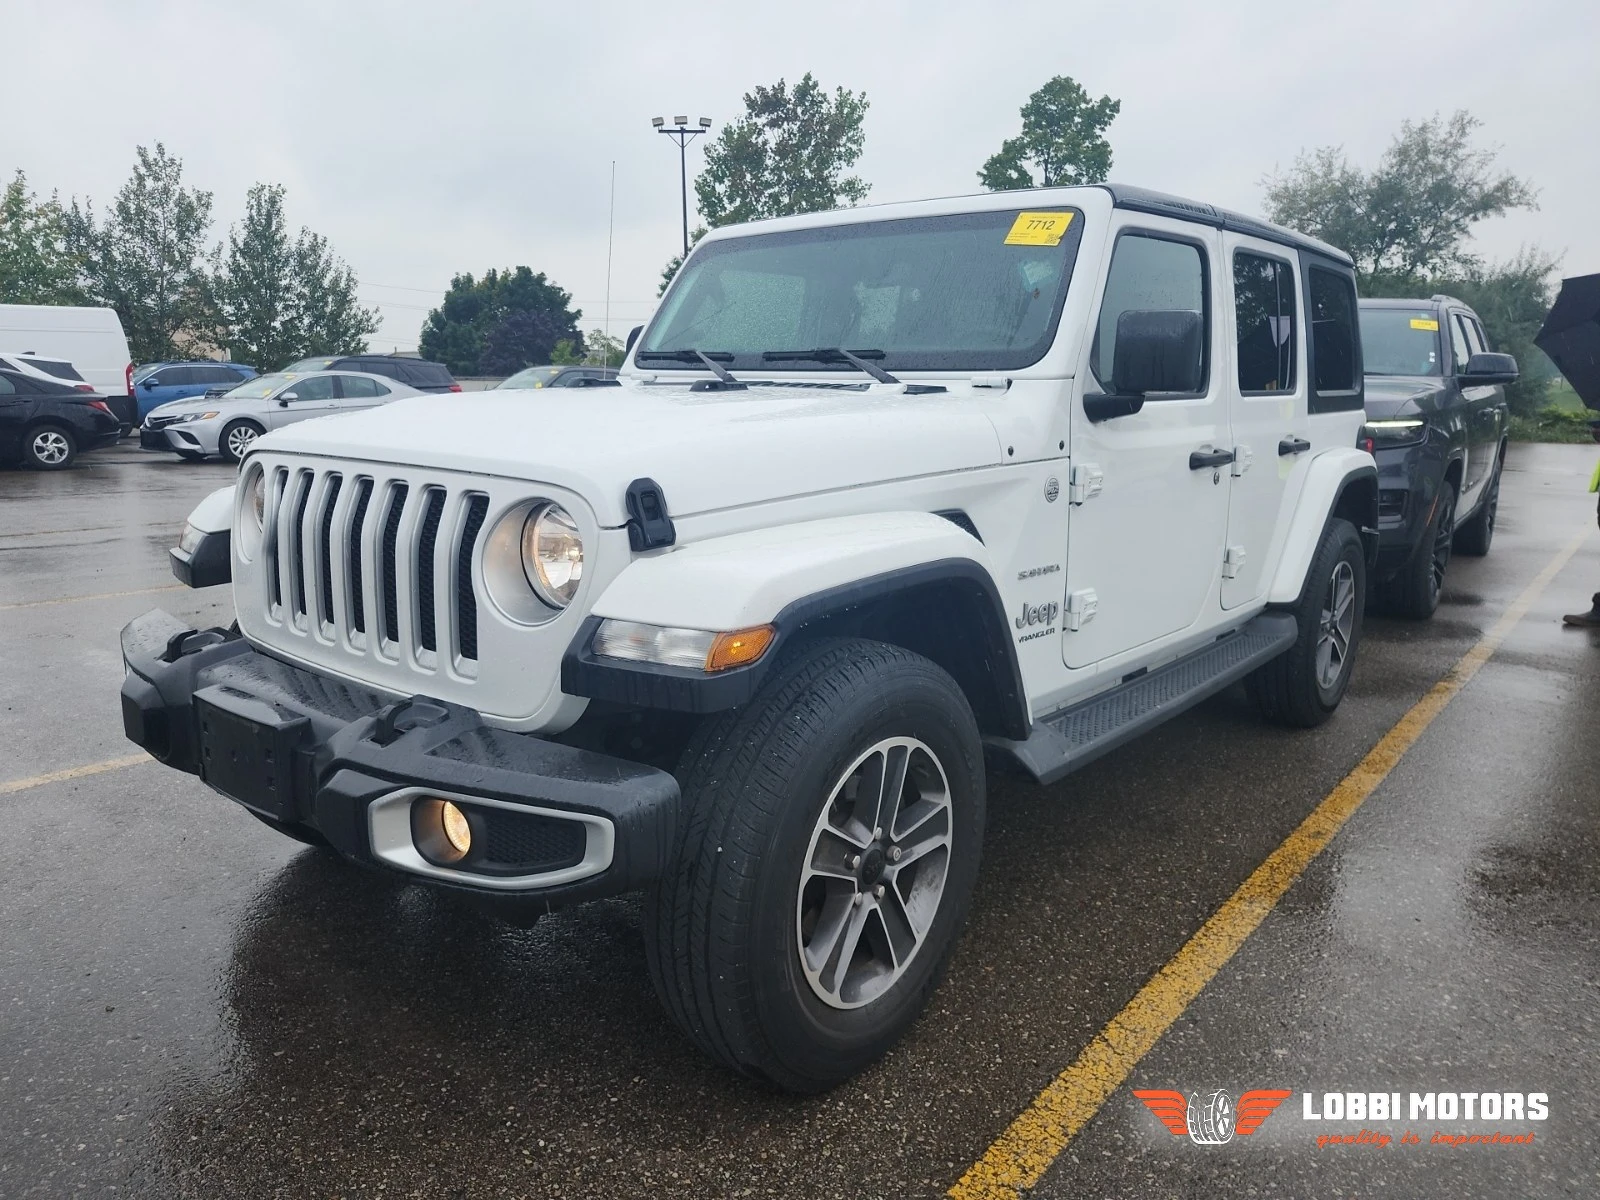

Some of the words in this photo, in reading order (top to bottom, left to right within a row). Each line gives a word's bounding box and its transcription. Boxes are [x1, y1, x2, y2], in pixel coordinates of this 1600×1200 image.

[1026, 220, 1056, 230] 7712
[1015, 602, 1058, 629] Jeep
[1018, 627, 1055, 643] WRANGLER
